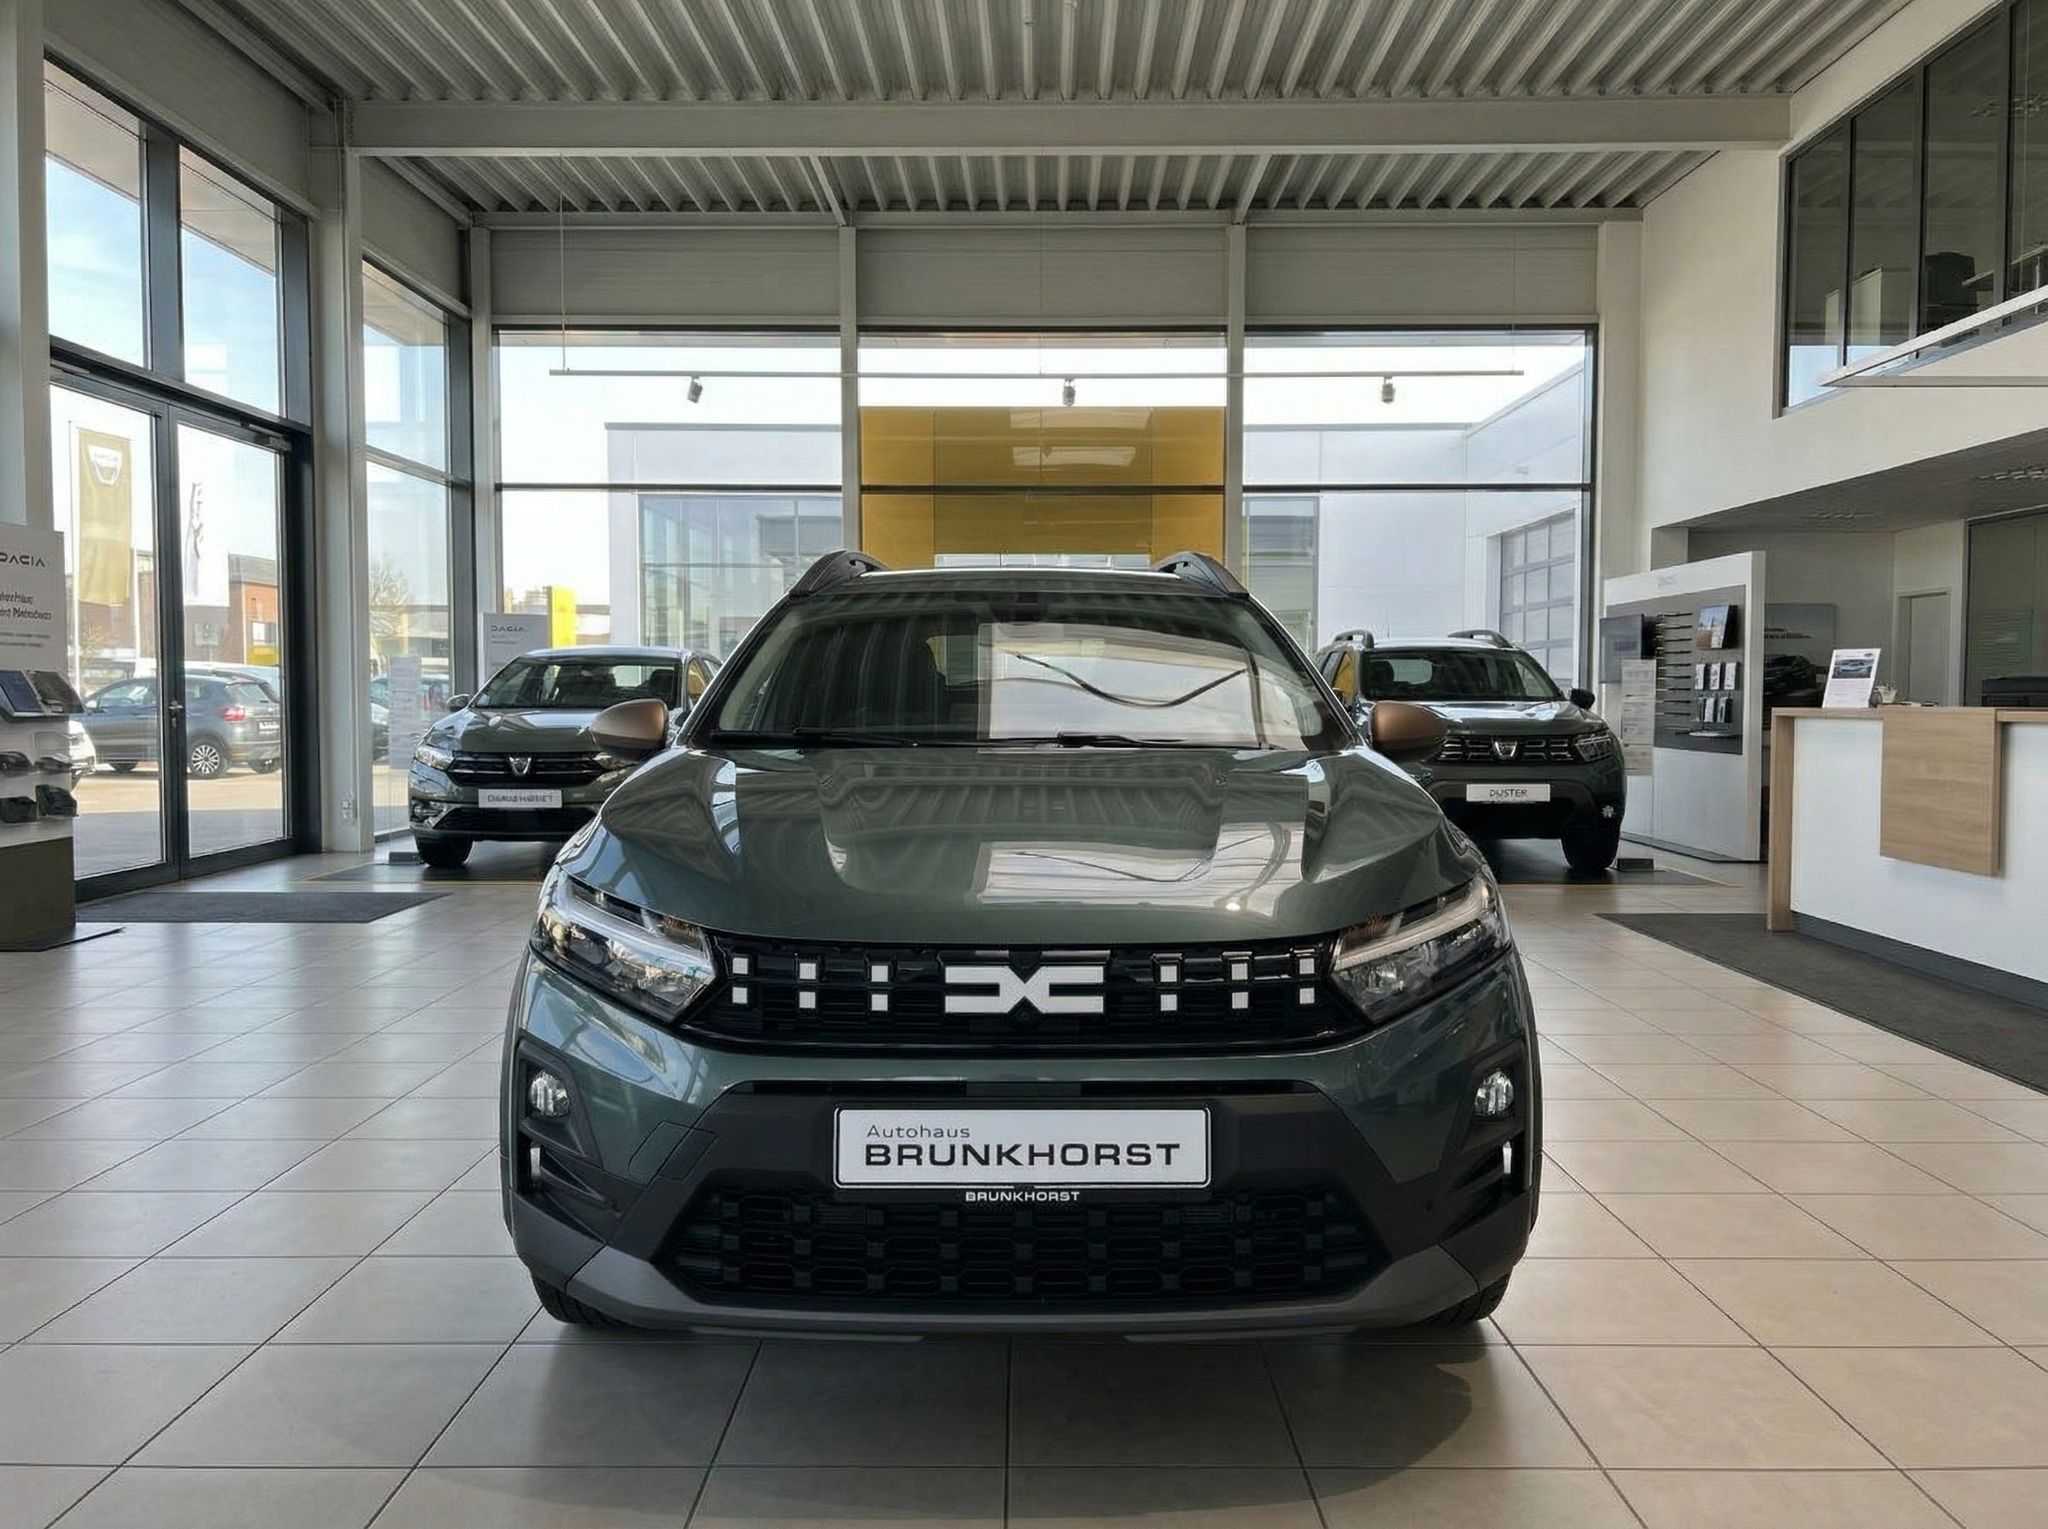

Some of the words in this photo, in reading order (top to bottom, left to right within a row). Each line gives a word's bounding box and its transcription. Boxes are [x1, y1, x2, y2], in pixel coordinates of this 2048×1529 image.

[866, 1124, 971, 1139] Autohaus
[865, 1143, 1181, 1167] BRUNKHORST
[965, 1191, 1081, 1202] BRUNKHORST
